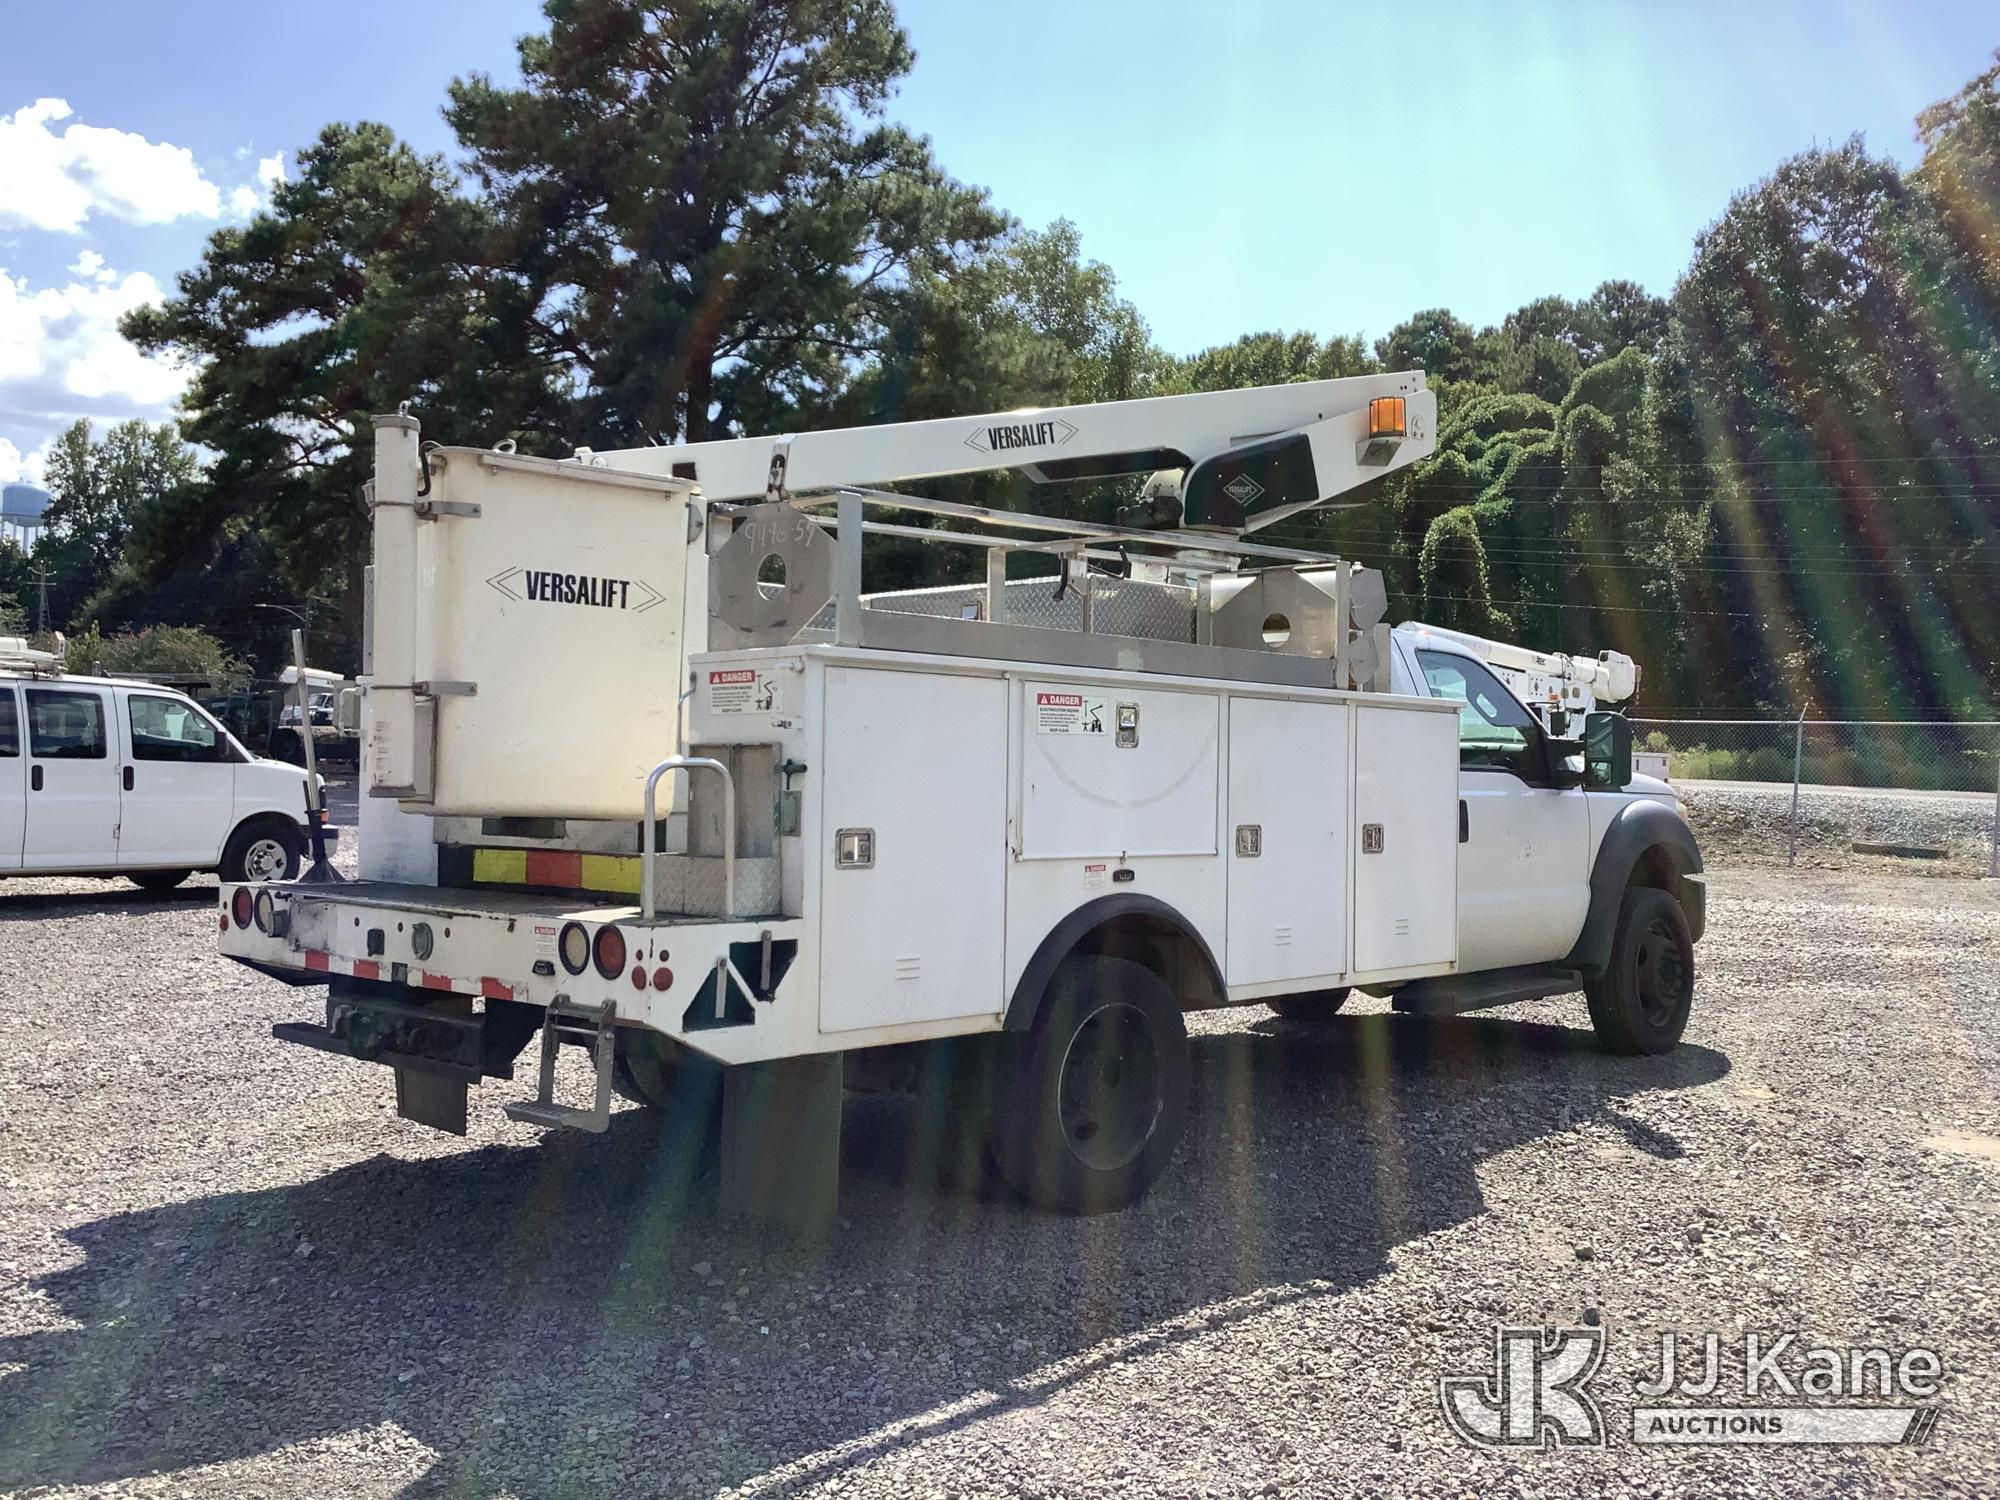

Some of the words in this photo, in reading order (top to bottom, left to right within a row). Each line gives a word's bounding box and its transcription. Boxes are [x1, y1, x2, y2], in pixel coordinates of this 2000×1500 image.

[988, 421, 1055, 450] VERSALIFT
[526, 570, 630, 609] VERSALIFT
[721, 672, 753, 682] DANGER
[1050, 695, 1080, 705] DANGER
